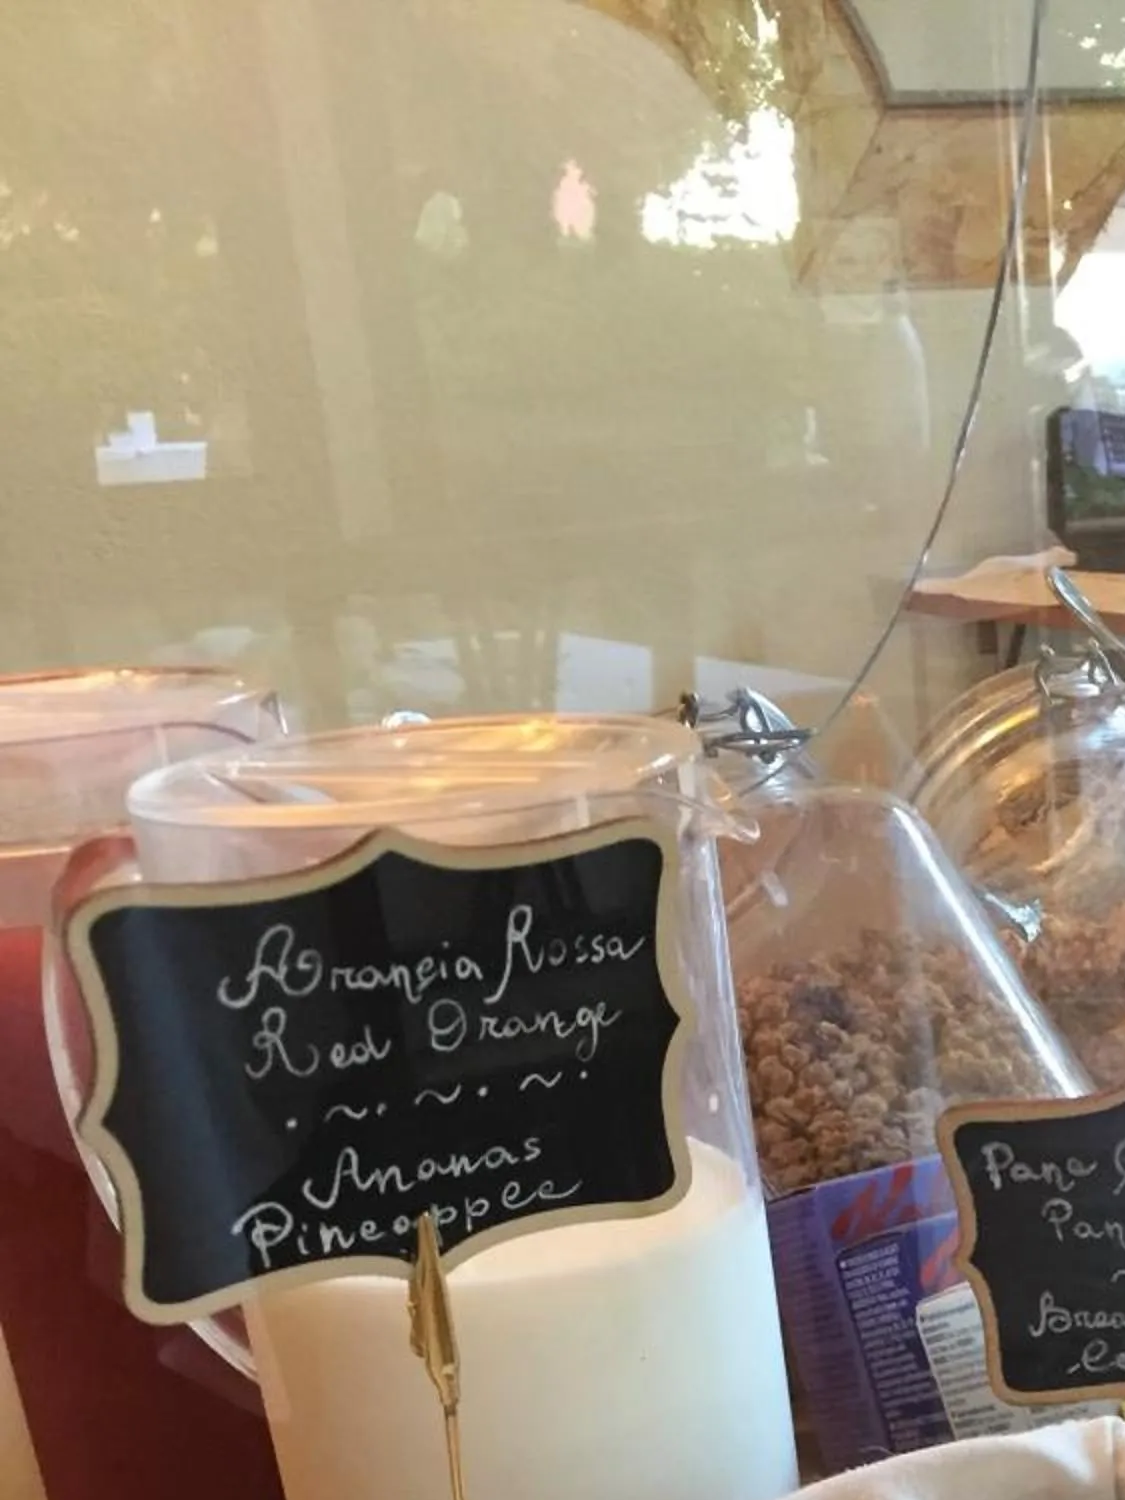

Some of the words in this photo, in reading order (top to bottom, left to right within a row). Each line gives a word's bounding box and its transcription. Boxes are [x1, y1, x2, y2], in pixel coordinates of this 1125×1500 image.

[484, 904, 646, 1003] Rossa
[245, 1006, 391, 1078] Red
[428, 999, 623, 1061] Orange
[302, 1136, 542, 1209] Ananas
[981, 1142, 1098, 1192] Pane
